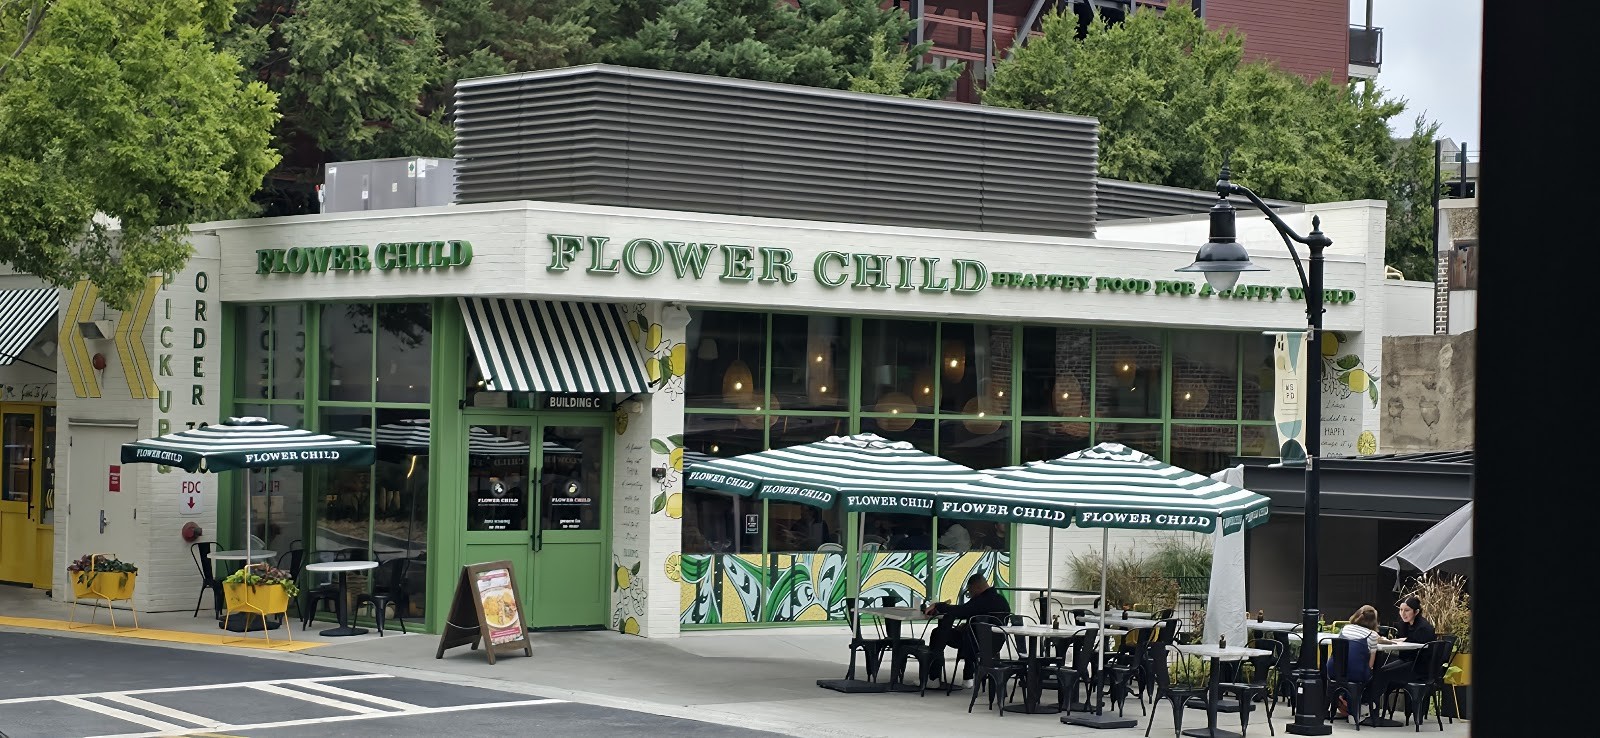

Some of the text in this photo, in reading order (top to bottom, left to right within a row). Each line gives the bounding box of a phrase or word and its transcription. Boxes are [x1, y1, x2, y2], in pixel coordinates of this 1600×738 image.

[255, 239, 473, 275] FLOWER CHILD
[546, 233, 988, 294] FLOWER CHILD
[991, 272, 1092, 290] HEALTHY
[1096, 276, 1151, 293] FOOD
[1155, 280, 1196, 295] FOR
[1199, 283, 1216, 297] A
[1287, 287, 1356, 305] WRLD
[192, 271, 209, 406] ORDER
[158, 268, 175, 437] PICKUP
[549, 396, 600, 408] BUILDING C
[1324, 427, 1345, 436] HAPPY
[136, 448, 183, 463] FLOWER CHILD
[245, 450, 340, 463] FLOWER CHILD
[181, 481, 201, 494] FDC
[689, 471, 755, 490] FLOWER CHILD
[761, 484, 832, 503] FLOWER CHILD
[847, 496, 898, 506] FLOWER
[941, 501, 1067, 522] FLOWER CHILD
[1082, 511, 1151, 524] FLOWER
[1155, 513, 1211, 528] CHILD
